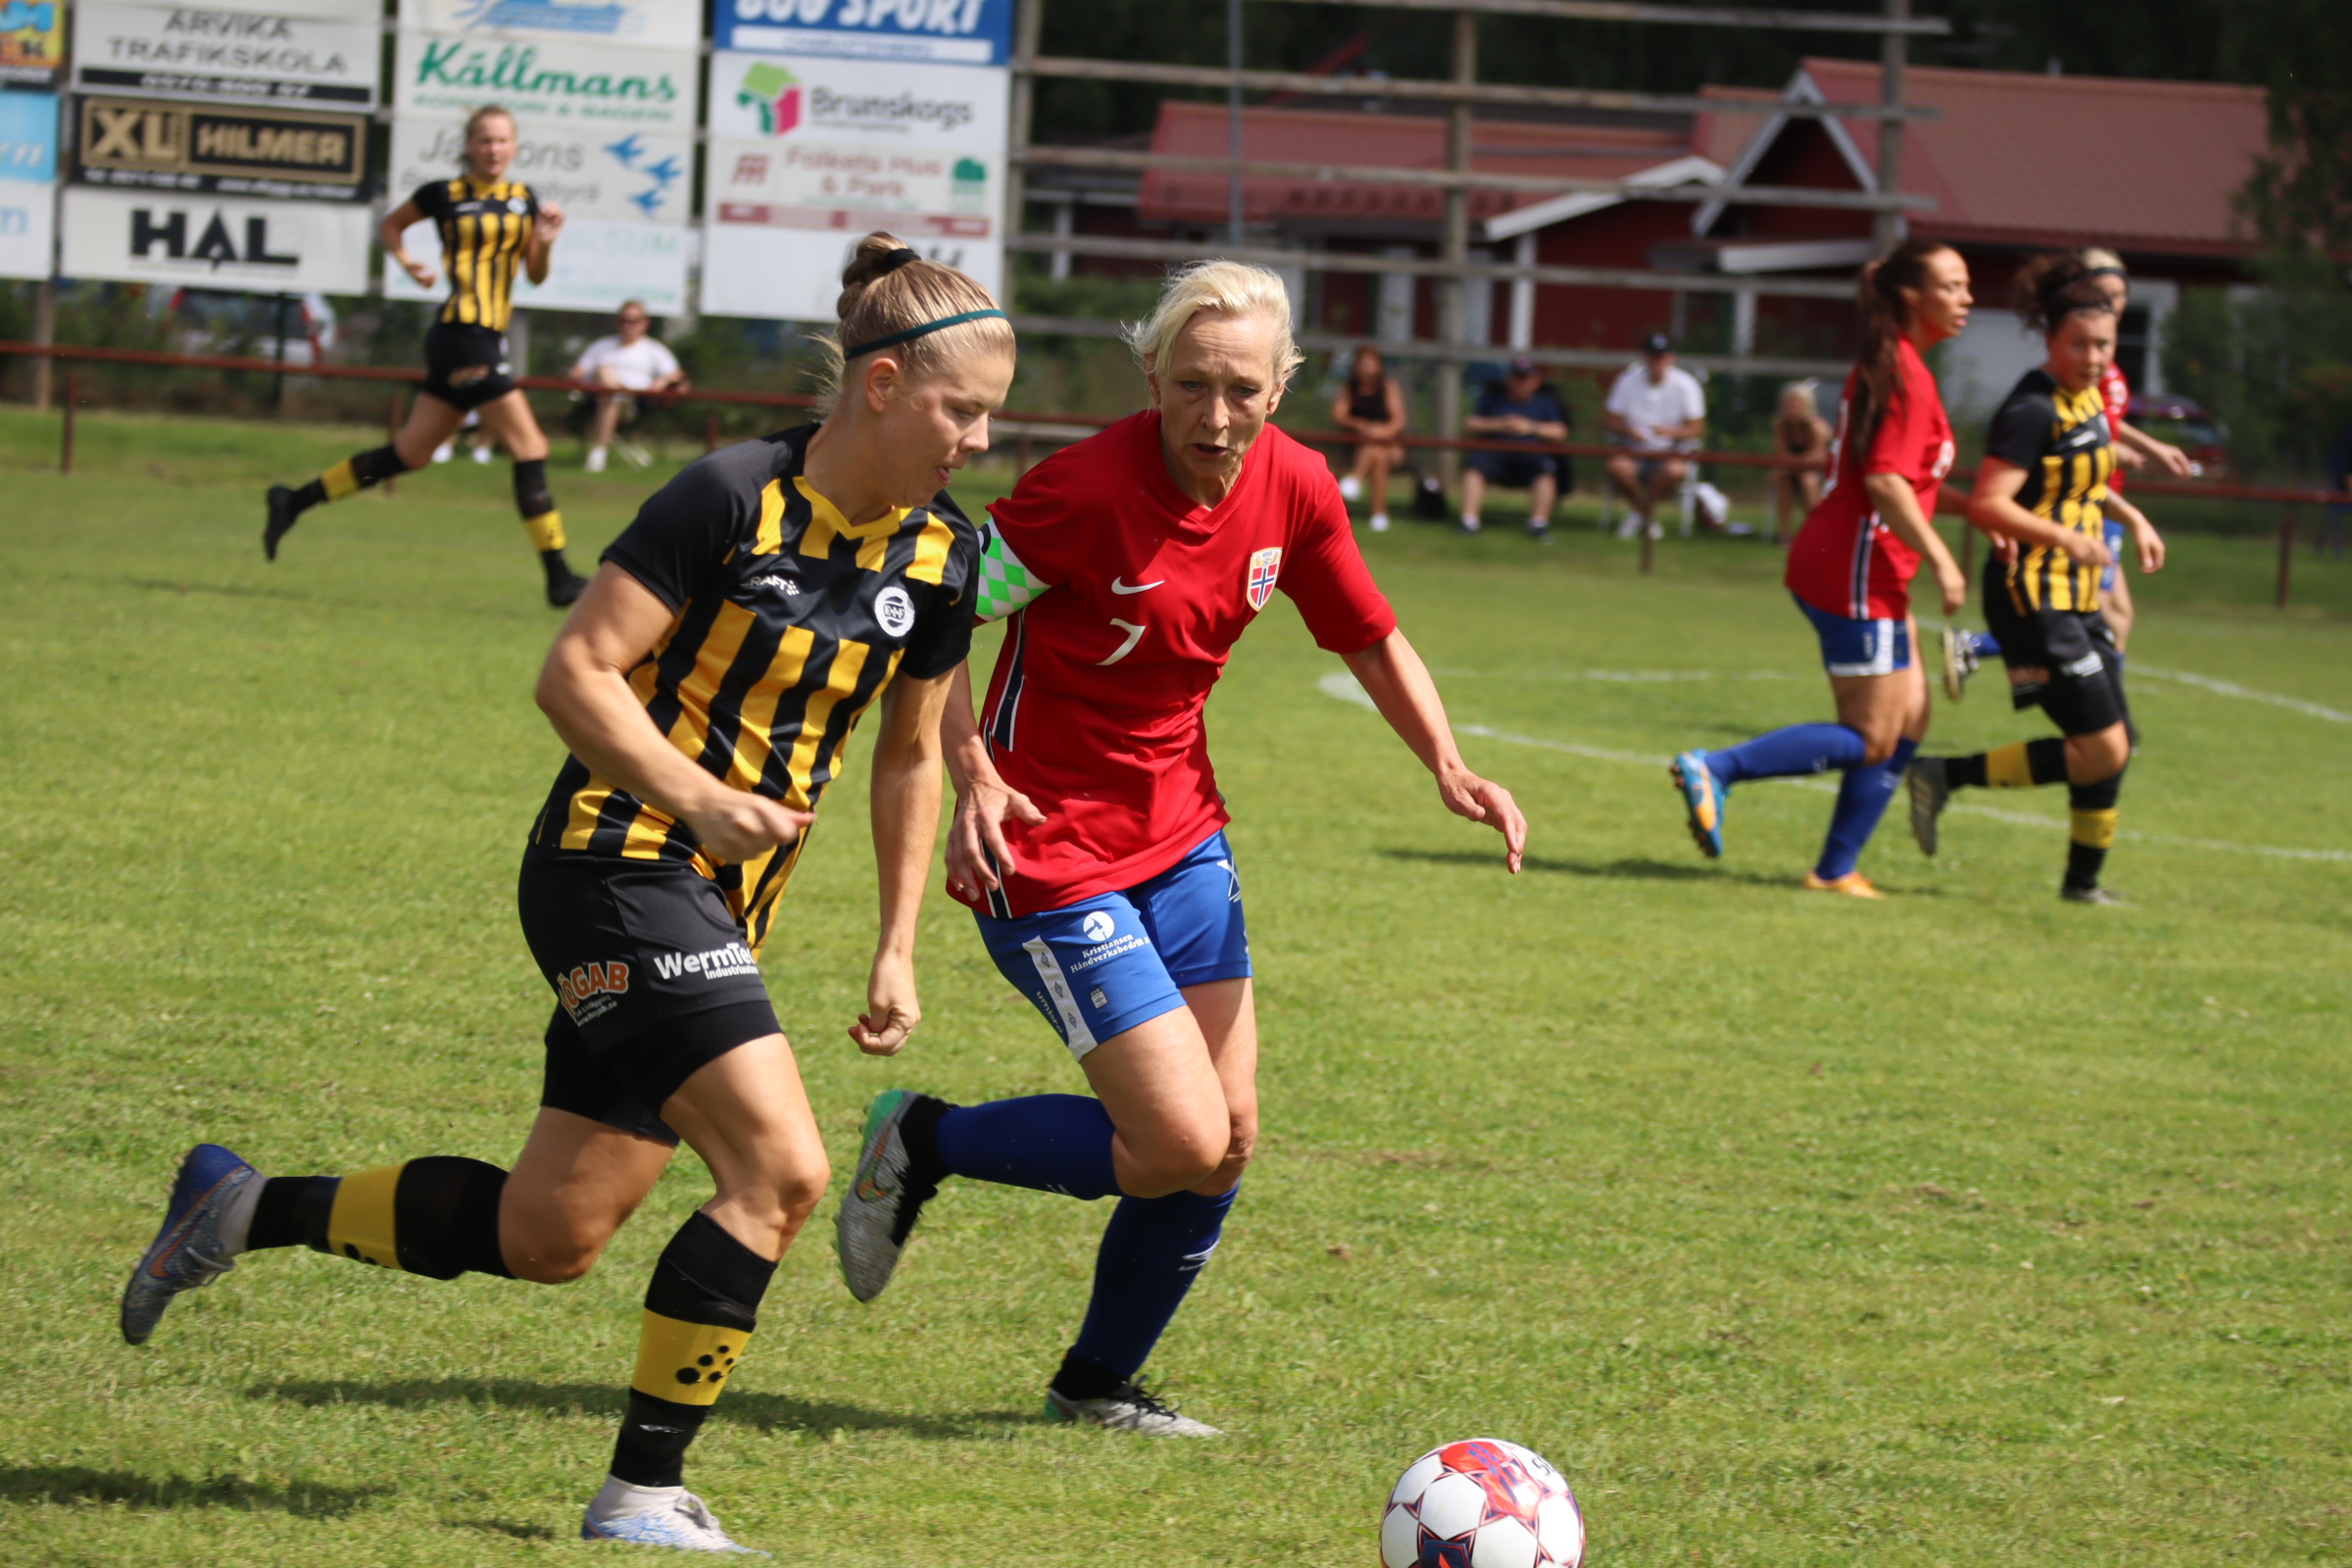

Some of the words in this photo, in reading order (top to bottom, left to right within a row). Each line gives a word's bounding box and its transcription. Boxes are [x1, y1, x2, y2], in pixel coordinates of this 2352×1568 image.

[164, 8, 291, 41] ARVIKA
[106, 35, 349, 75] TRAFIKSKOLA
[810, 85, 974, 132] Brunskogs
[92, 107, 178, 161] XL
[196, 122, 346, 167] HILMER
[130, 207, 299, 270] HAL
[1095, 617, 1147, 666] 7
[1069, 937, 1146, 973] Håndverksbedrift
[1081, 933, 1134, 959] Kristiansen
[1036, 990, 1064, 1034] umbro
